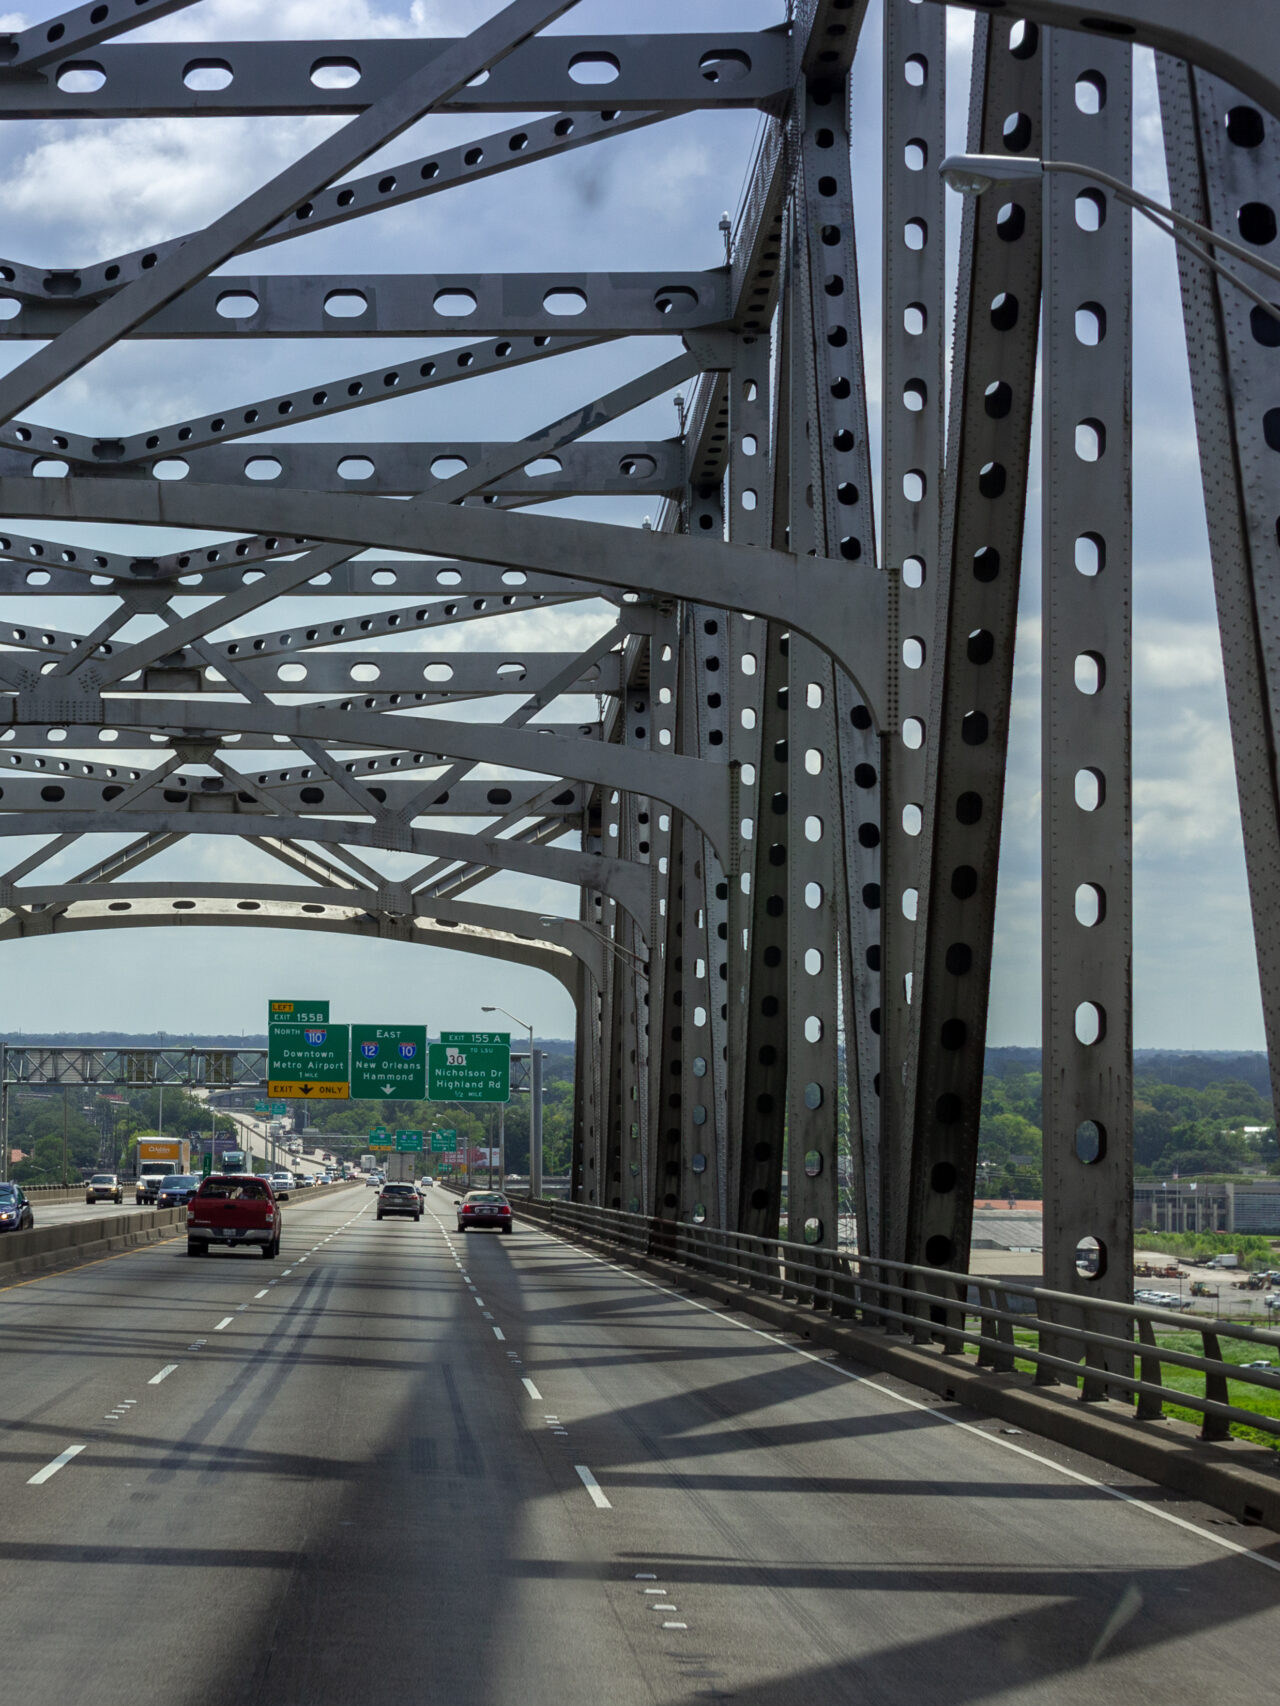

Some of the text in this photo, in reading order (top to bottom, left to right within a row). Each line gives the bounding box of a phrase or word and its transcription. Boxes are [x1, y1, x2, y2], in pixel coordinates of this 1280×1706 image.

[274, 1013, 323, 1022] EXIT 155B
[308, 1033, 322, 1043] 110
[376, 1029, 402, 1038] EAST
[471, 1034, 489, 1043] 155
[493, 1035, 501, 1043] A
[283, 1050, 334, 1058] Downtown
[364, 1046, 376, 1056] 12
[402, 1046, 413, 1056] 10
[448, 1054, 464, 1065] 30
[273, 1061, 344, 1070] Metro Airport
[356, 1061, 421, 1070] New Orleans
[363, 1072, 414, 1081] Hammond
[435, 1069, 486, 1077] Nicholson
[273, 1085, 293, 1093] EXIT
[436, 1080, 484, 1090] Highland
